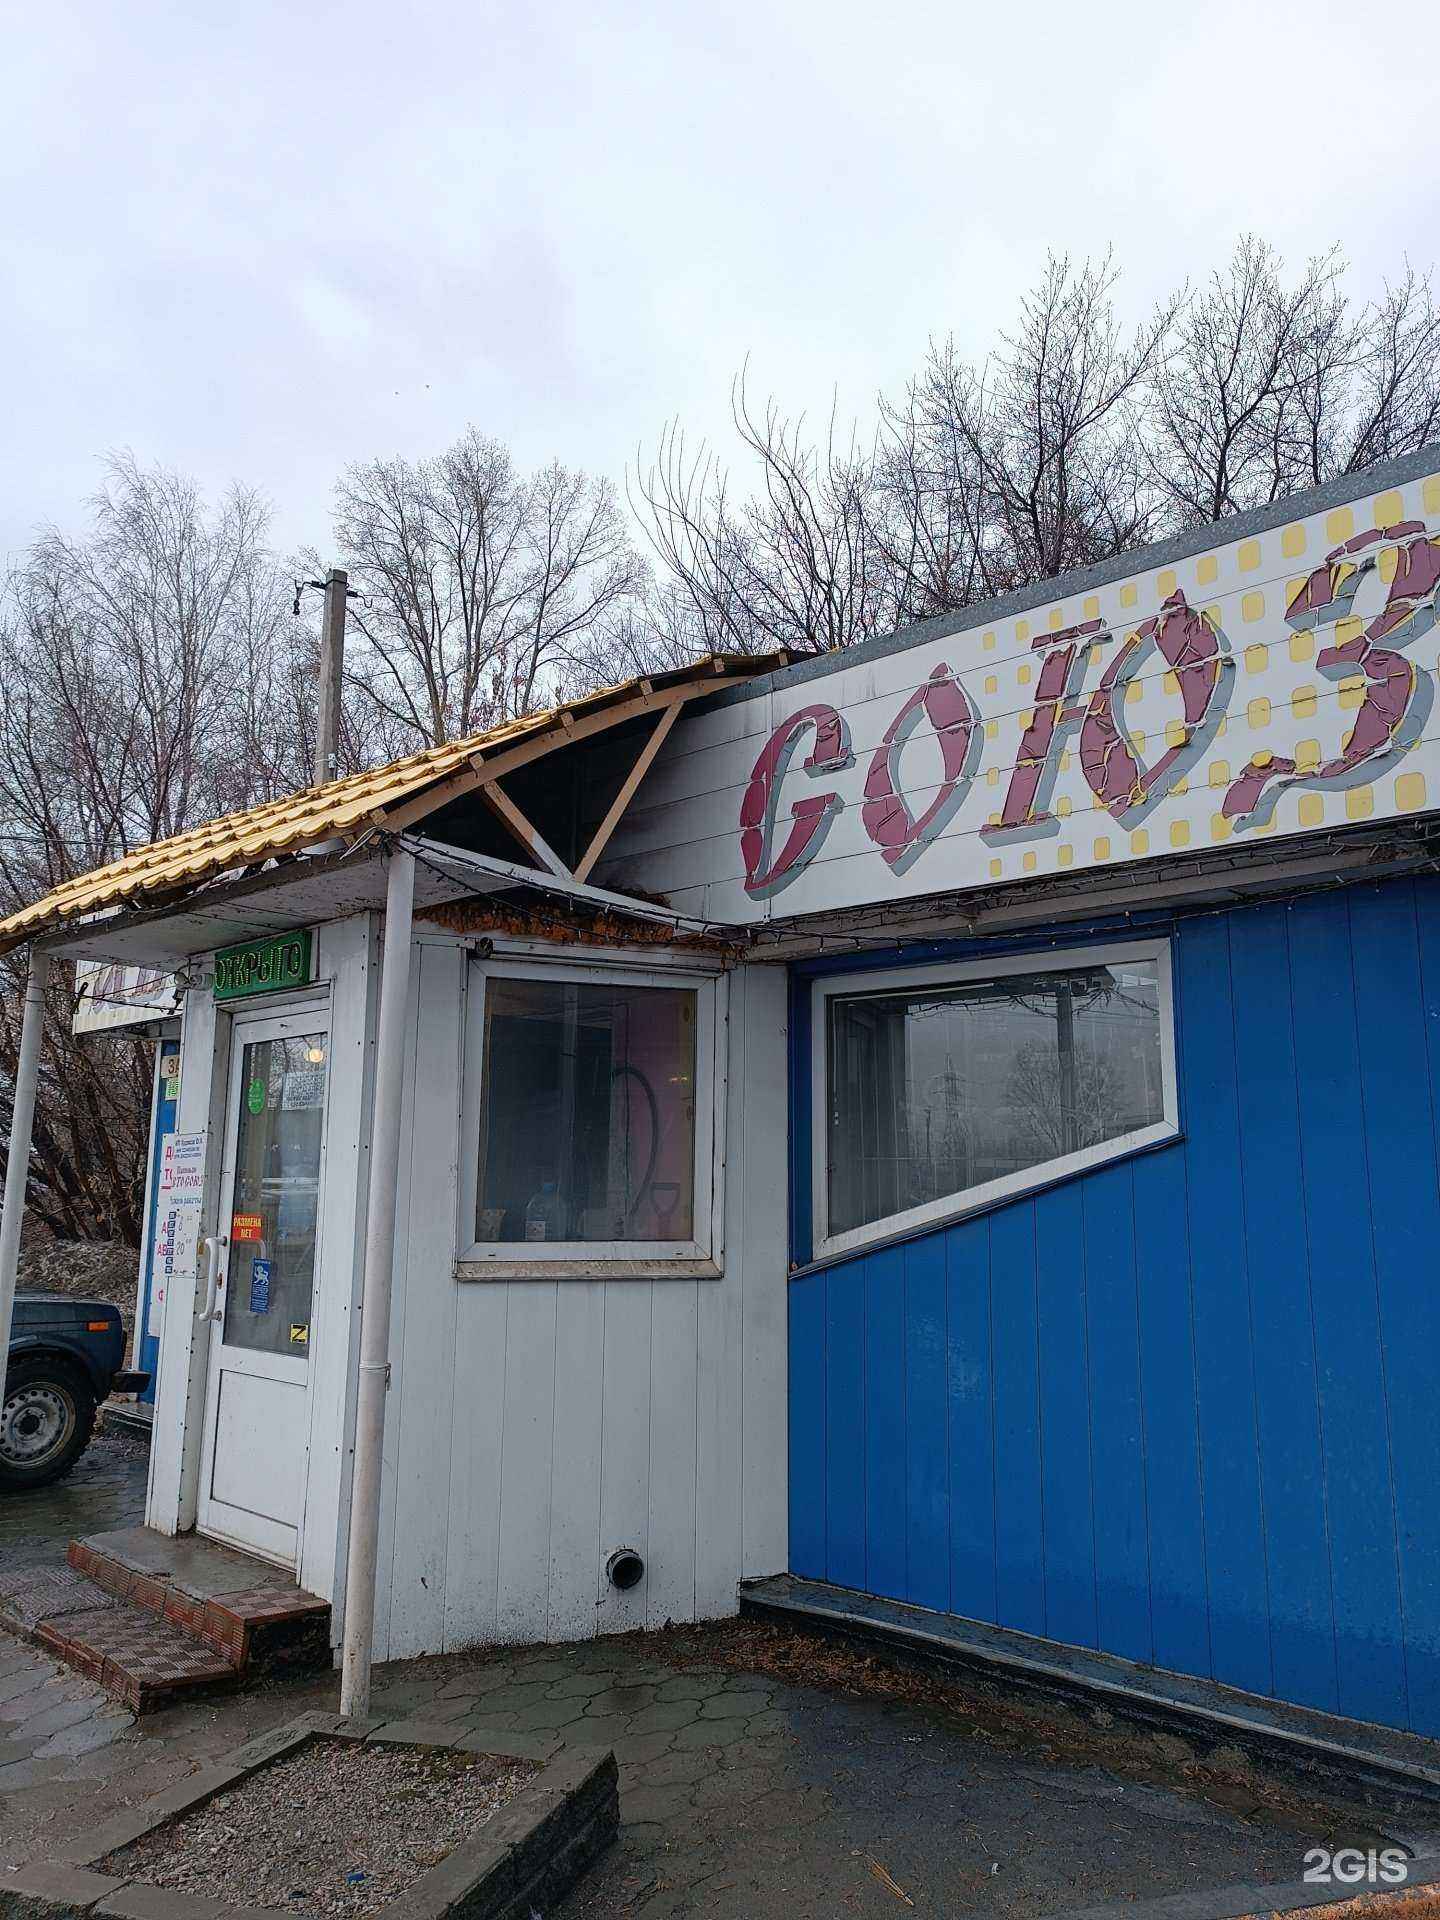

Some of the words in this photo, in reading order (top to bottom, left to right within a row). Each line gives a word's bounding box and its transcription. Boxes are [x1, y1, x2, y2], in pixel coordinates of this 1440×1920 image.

[215, 941, 304, 991] ОТКРЫТО
[233, 1216, 262, 1228] РАЗМЕНА
[240, 1228, 253, 1239] НЕТ
